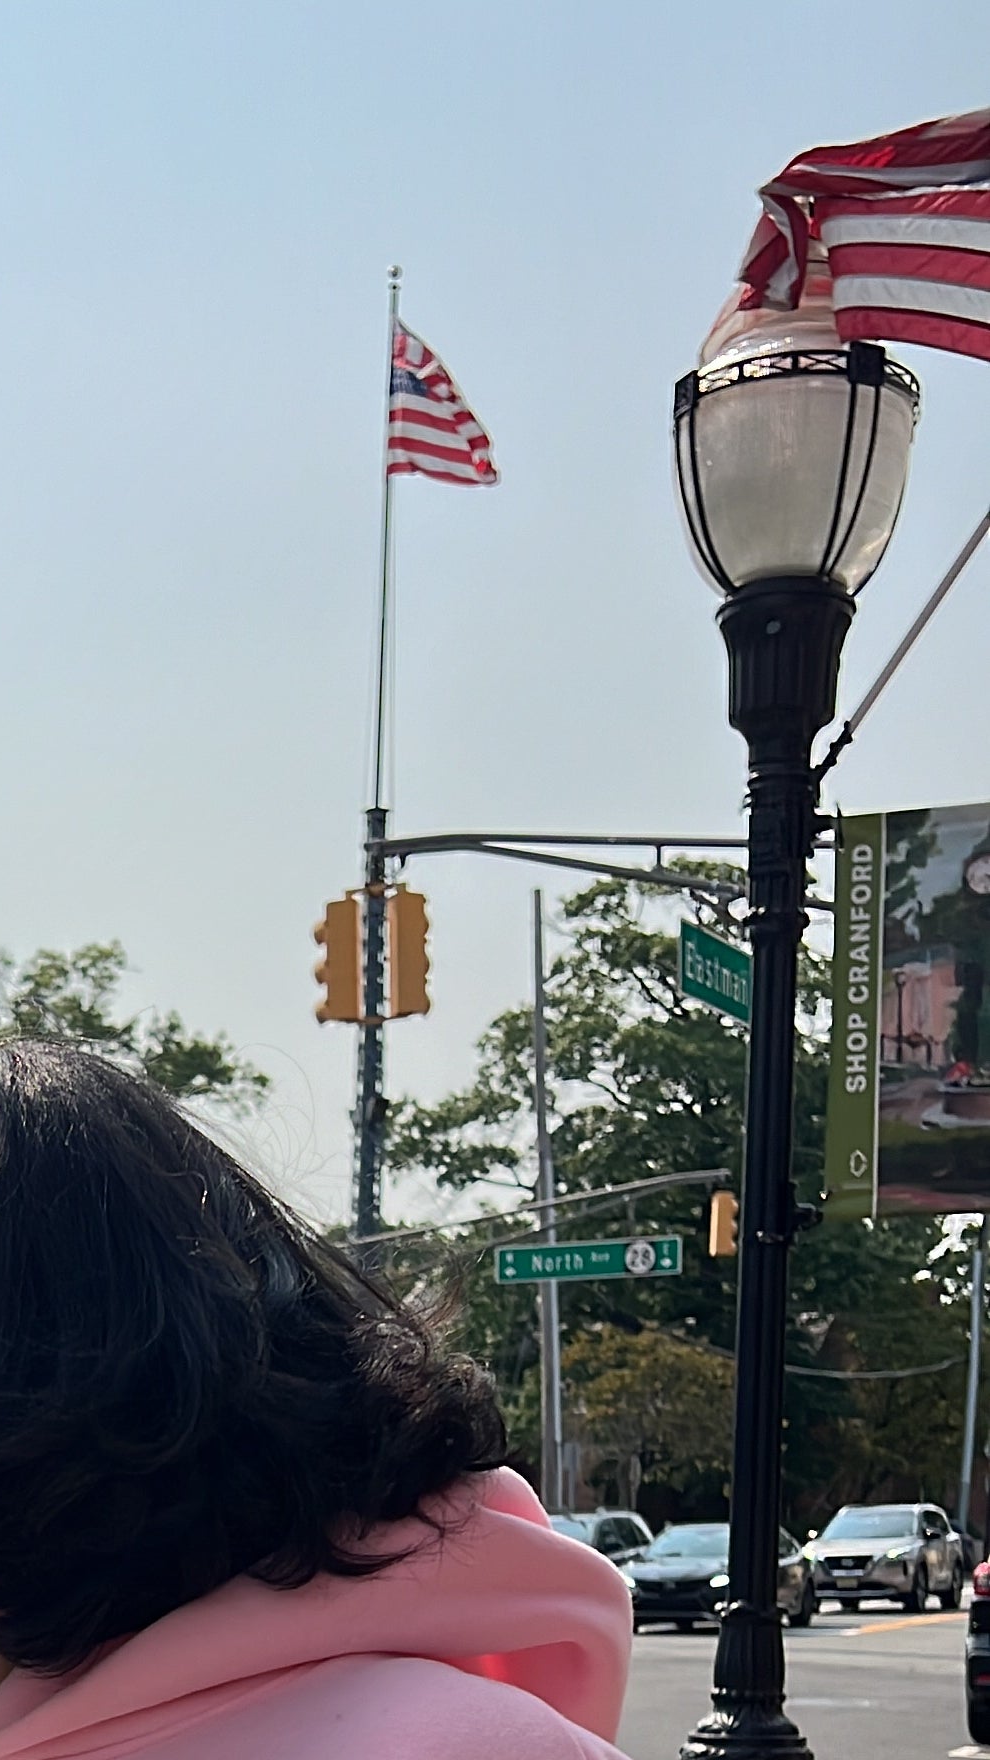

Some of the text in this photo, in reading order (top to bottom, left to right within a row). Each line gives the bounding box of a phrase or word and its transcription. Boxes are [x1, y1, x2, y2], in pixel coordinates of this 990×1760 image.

[684, 940, 749, 1007] Eastman
[845, 844, 873, 1093] SHOP CRANFORD
[531, 1253, 584, 1272] North
